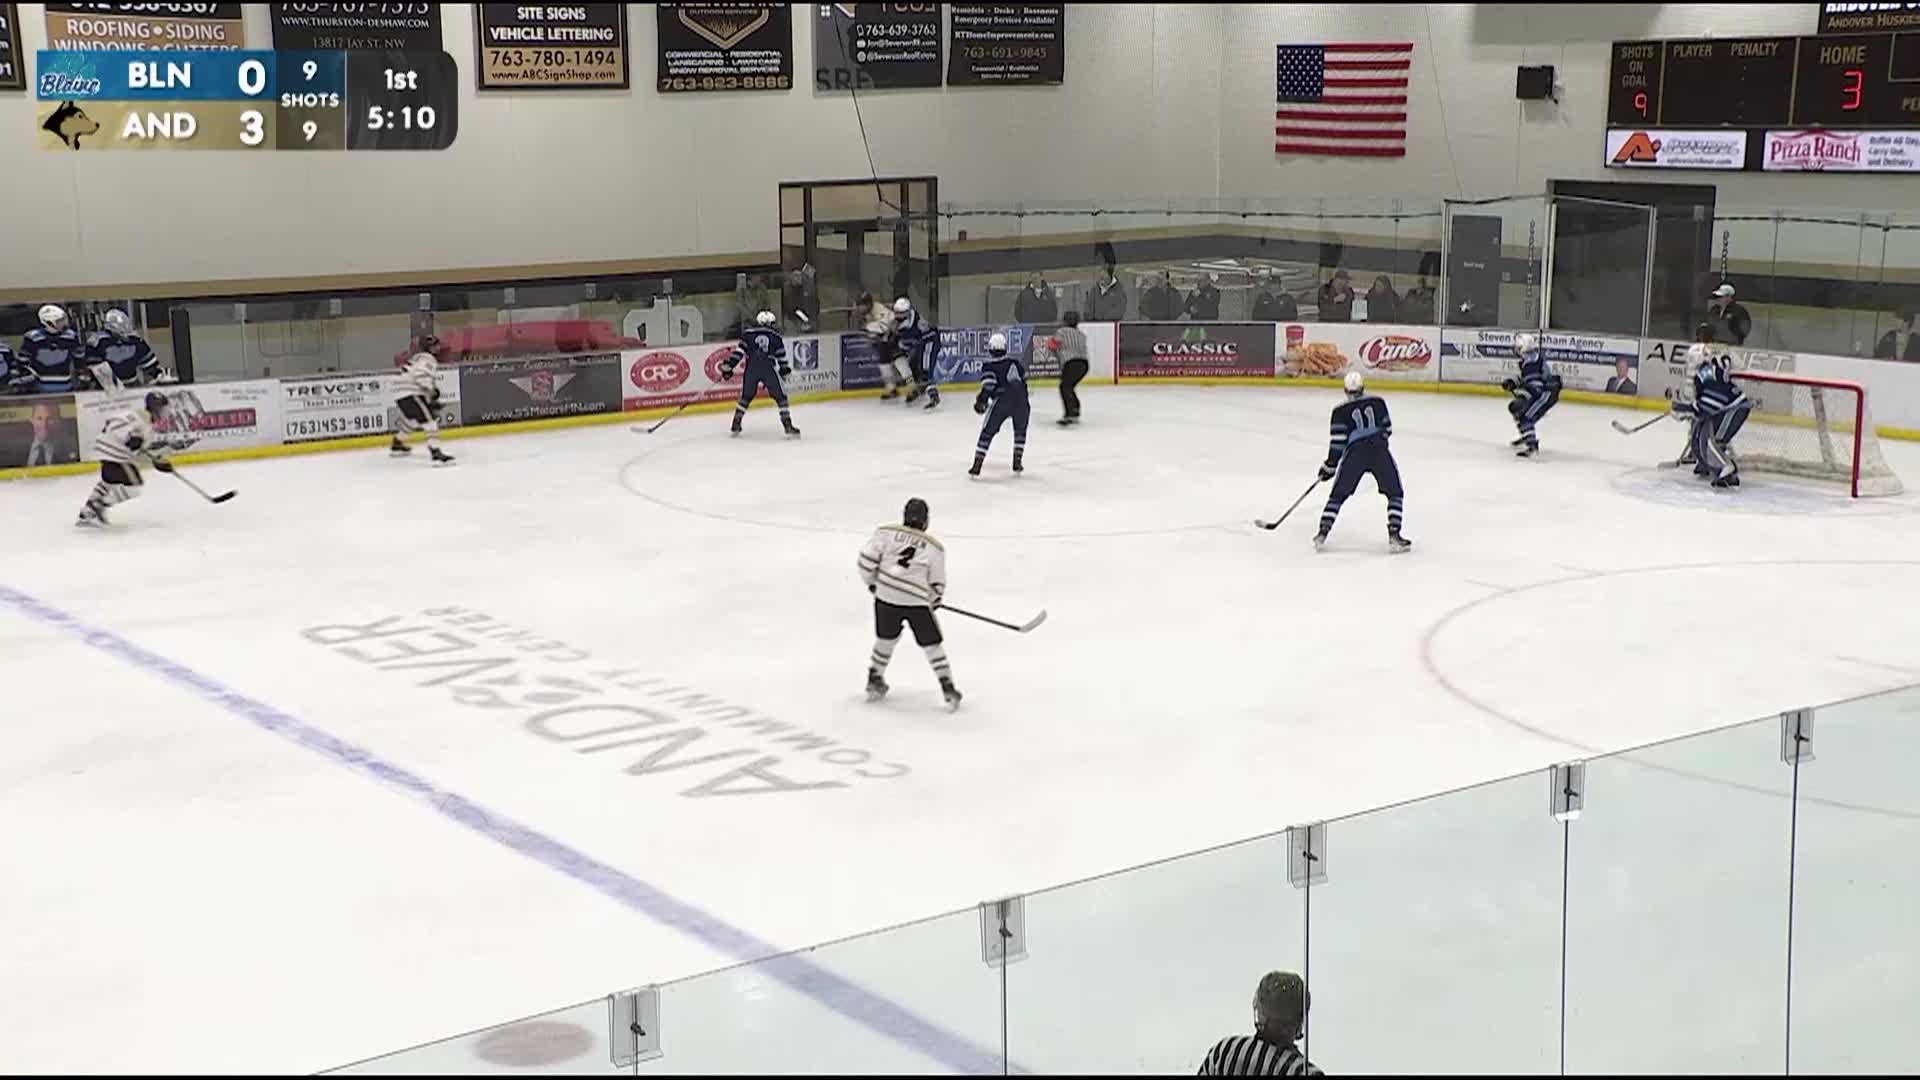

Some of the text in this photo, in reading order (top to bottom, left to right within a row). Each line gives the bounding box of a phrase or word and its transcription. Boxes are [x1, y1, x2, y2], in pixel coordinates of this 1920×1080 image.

[281, 16, 430, 28] WWW.THURSTON-DESHAW.COM
[517, 7, 586, 20] SITE SIGNS
[66, 18, 225, 40] ROOFING SIDING
[490, 27, 614, 40] VEHICLE LETTERING
[866, 24, 936, 36] 763-639-3763
[313, 36, 343, 48] 13817
[384, 39, 406, 48] NW
[1673, 42, 1779, 57] PLAYER PENALTY
[490, 50, 616, 67] 763-780-1494
[1621, 46, 1654, 59] SHOTS
[1820, 46, 1867, 65] HOME
[491, 69, 616, 81] www.ABCSignShop.com
[1841, 71, 1863, 110] 3
[1634, 92, 1648, 118] 9
[1771, 137, 1861, 163] Pizza Ranch
[940, 332, 959, 342] IVE
[959, 328, 1023, 357] HEE
[1153, 342, 1238, 355] CLASSIC
[1478, 332, 1511, 343] Steven
[1569, 336, 1605, 350] Agency
[1362, 337, 1430, 369] Cane's
[641, 363, 678, 382] CRC
[287, 381, 380, 397] TREVOR'S
[1351, 405, 1376, 431] 11
[896, 546, 917, 569] 2
